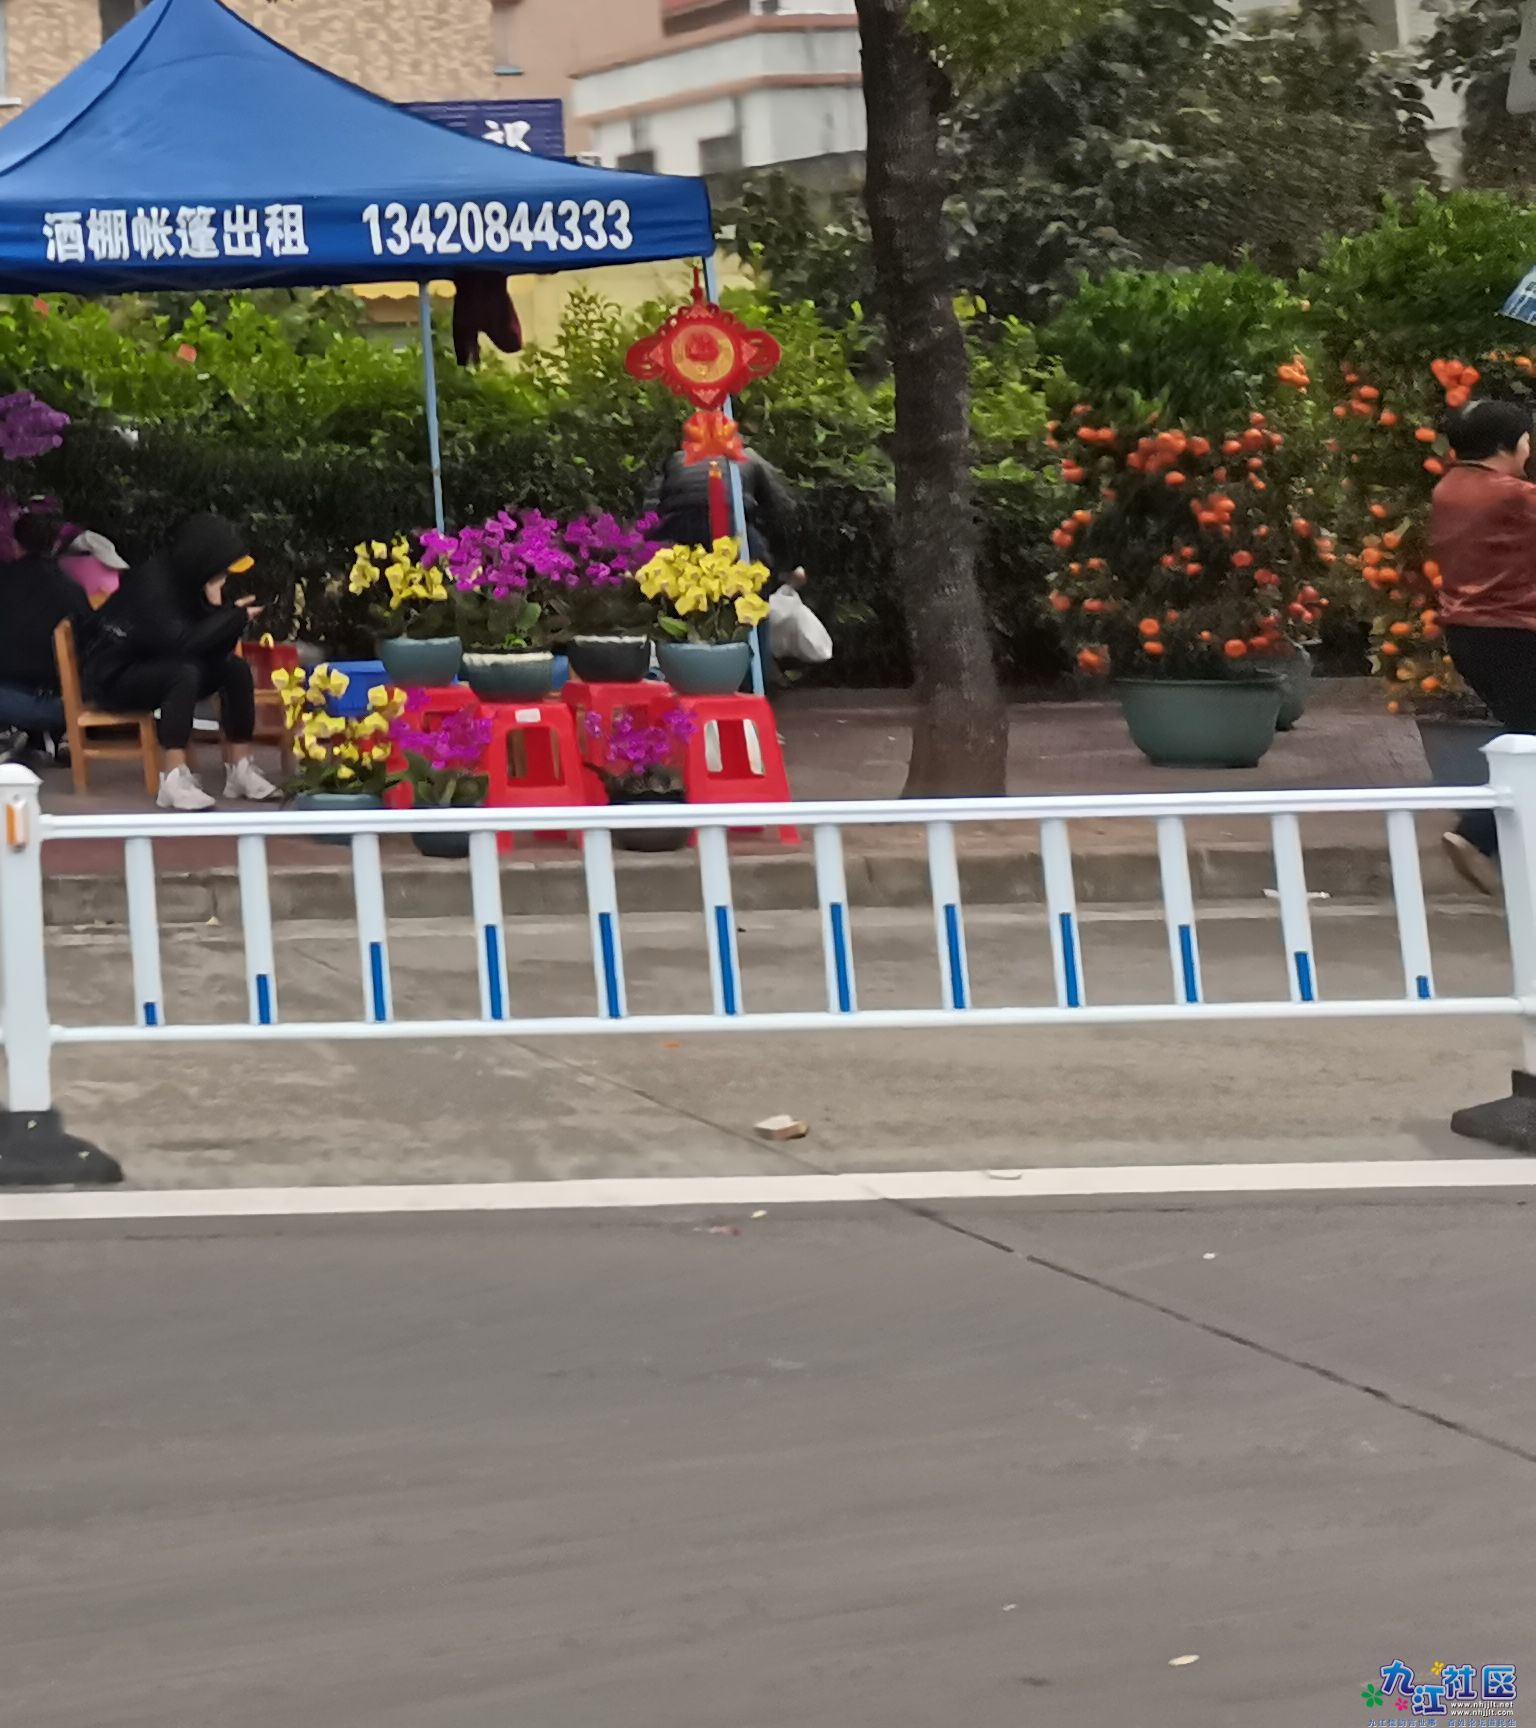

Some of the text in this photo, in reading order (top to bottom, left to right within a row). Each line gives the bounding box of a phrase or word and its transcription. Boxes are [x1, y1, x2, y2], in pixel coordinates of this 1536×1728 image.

[42, 199, 633, 264] 酒棚帐篷出租 13420844333
